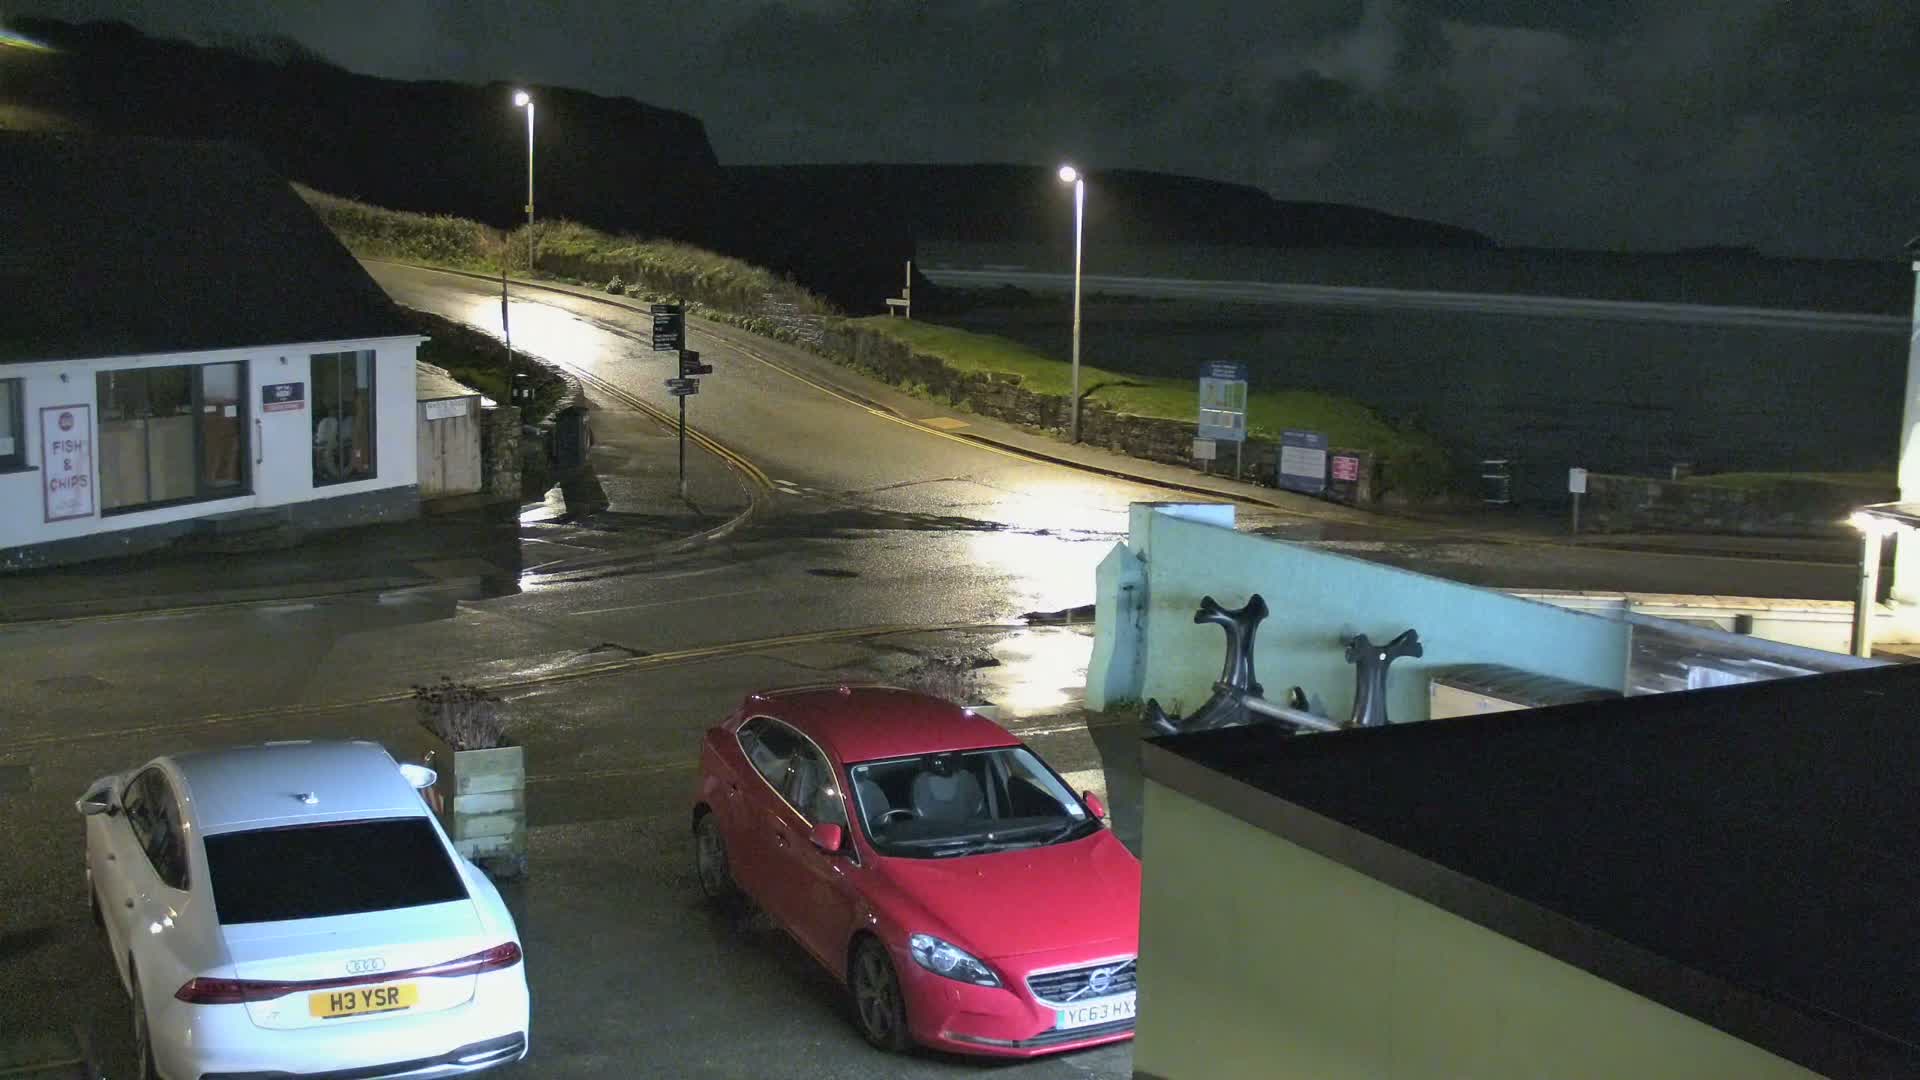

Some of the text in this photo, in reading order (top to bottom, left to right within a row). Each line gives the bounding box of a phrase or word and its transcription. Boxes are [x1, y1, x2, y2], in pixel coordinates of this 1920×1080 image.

[52, 440, 82, 456] FISH
[63, 458, 72, 471] &
[49, 475, 89, 492] CHIPS
[330, 986, 399, 1012] H3 YSR
[1068, 1000, 1137, 1025] YC63 HX
